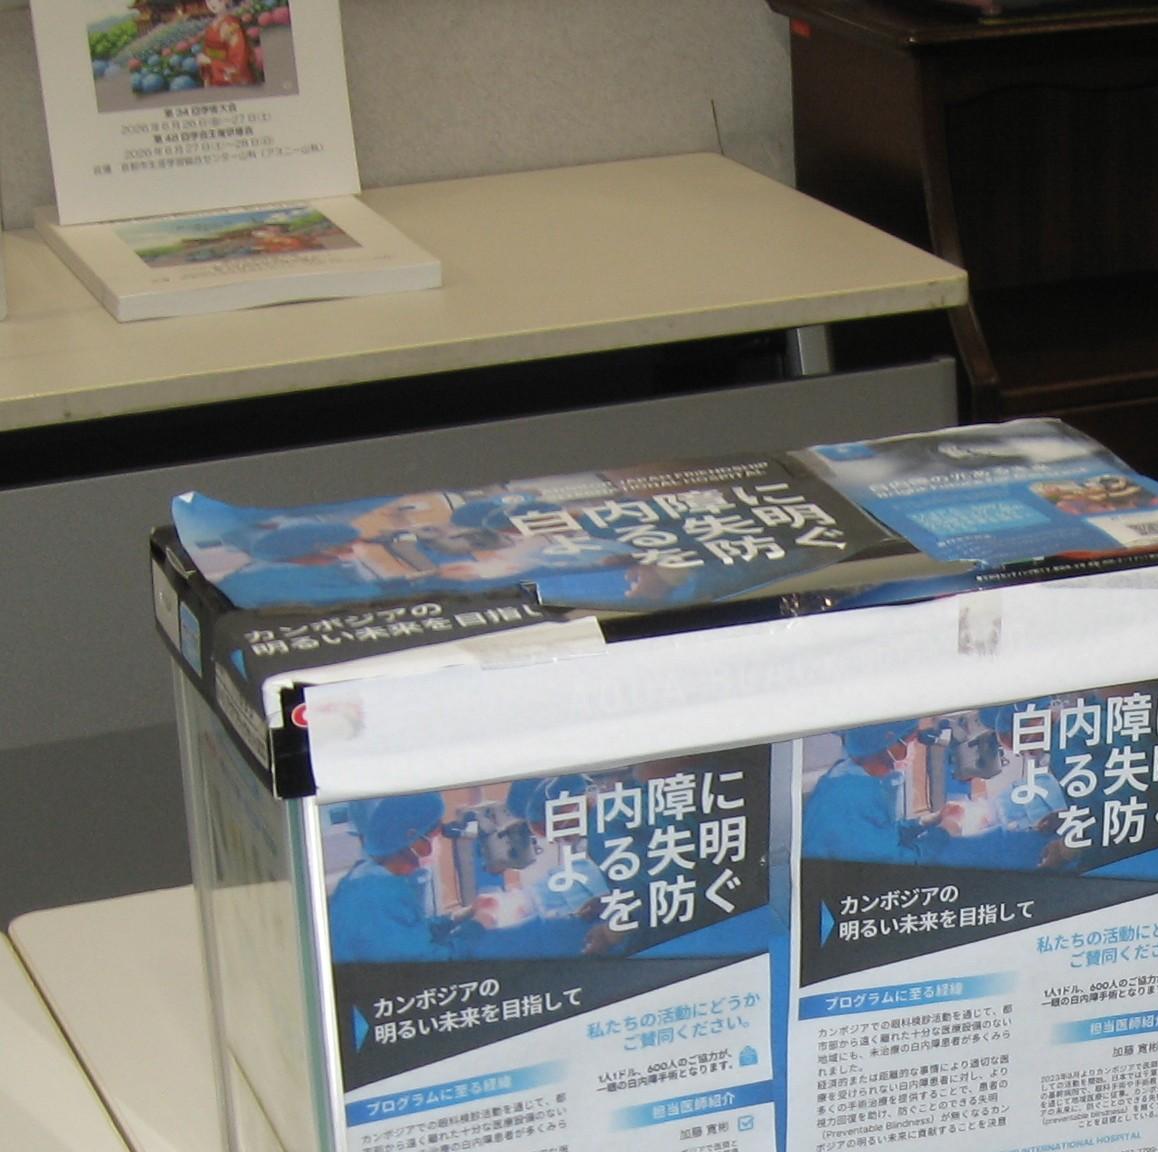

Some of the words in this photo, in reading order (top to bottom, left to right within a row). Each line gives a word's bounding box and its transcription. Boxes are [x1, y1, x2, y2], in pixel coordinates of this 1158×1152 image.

[508, 482, 806, 537] 白内障に
[543, 503, 838, 555] よる失明
[631, 525, 848, 568] を防ぐ
[245, 602, 444, 643] カンボジアの
[251, 603, 544, 658] 明るい未来を目指し
[545, 770, 744, 842] 白内障に
[547, 816, 748, 893] よる失明
[600, 868, 743, 933] を防ぐ
[839, 884, 959, 916] カンボジアの
[839, 900, 1035, 943] 明るい未来を目指して
[374, 977, 500, 1018] カンボジアの
[374, 987, 583, 1045] 明るい未来を目指して
[586, 992, 760, 1041] 私たちの活動にどうか
[623, 1016, 751, 1051] ご賛同ください。
[818, 1064, 864, 1077] れました。
